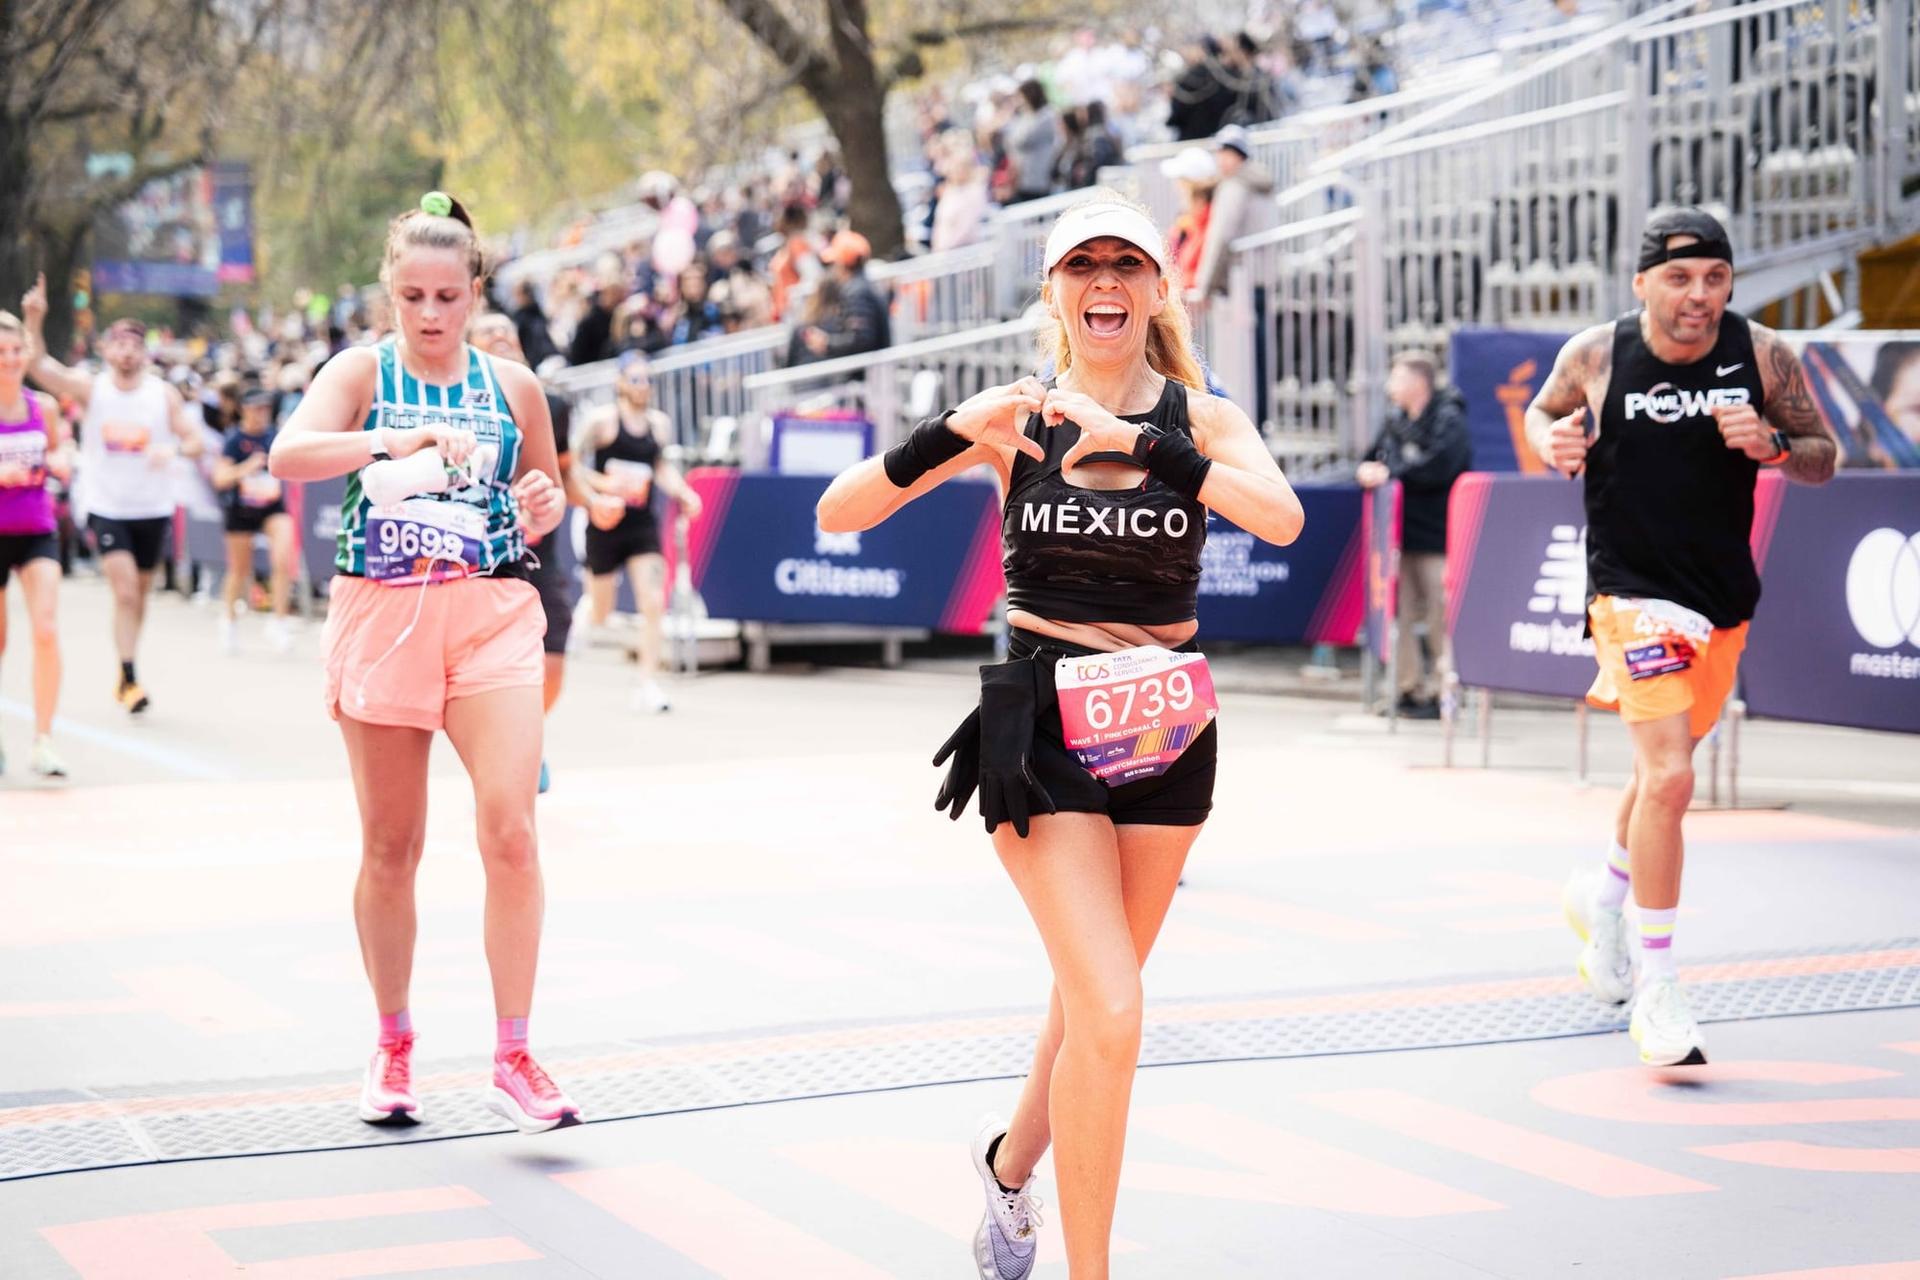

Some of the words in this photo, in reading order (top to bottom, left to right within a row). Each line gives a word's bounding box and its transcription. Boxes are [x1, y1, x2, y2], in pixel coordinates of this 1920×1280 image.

[1021, 498, 1188, 538] MÉXICO
[775, 558, 900, 597] Citizens
[1851, 652, 1920, 679] master
[1085, 670, 1194, 730] 6739
[1070, 735, 1092, 746] WAVE
[1152, 719, 1161, 728] C
